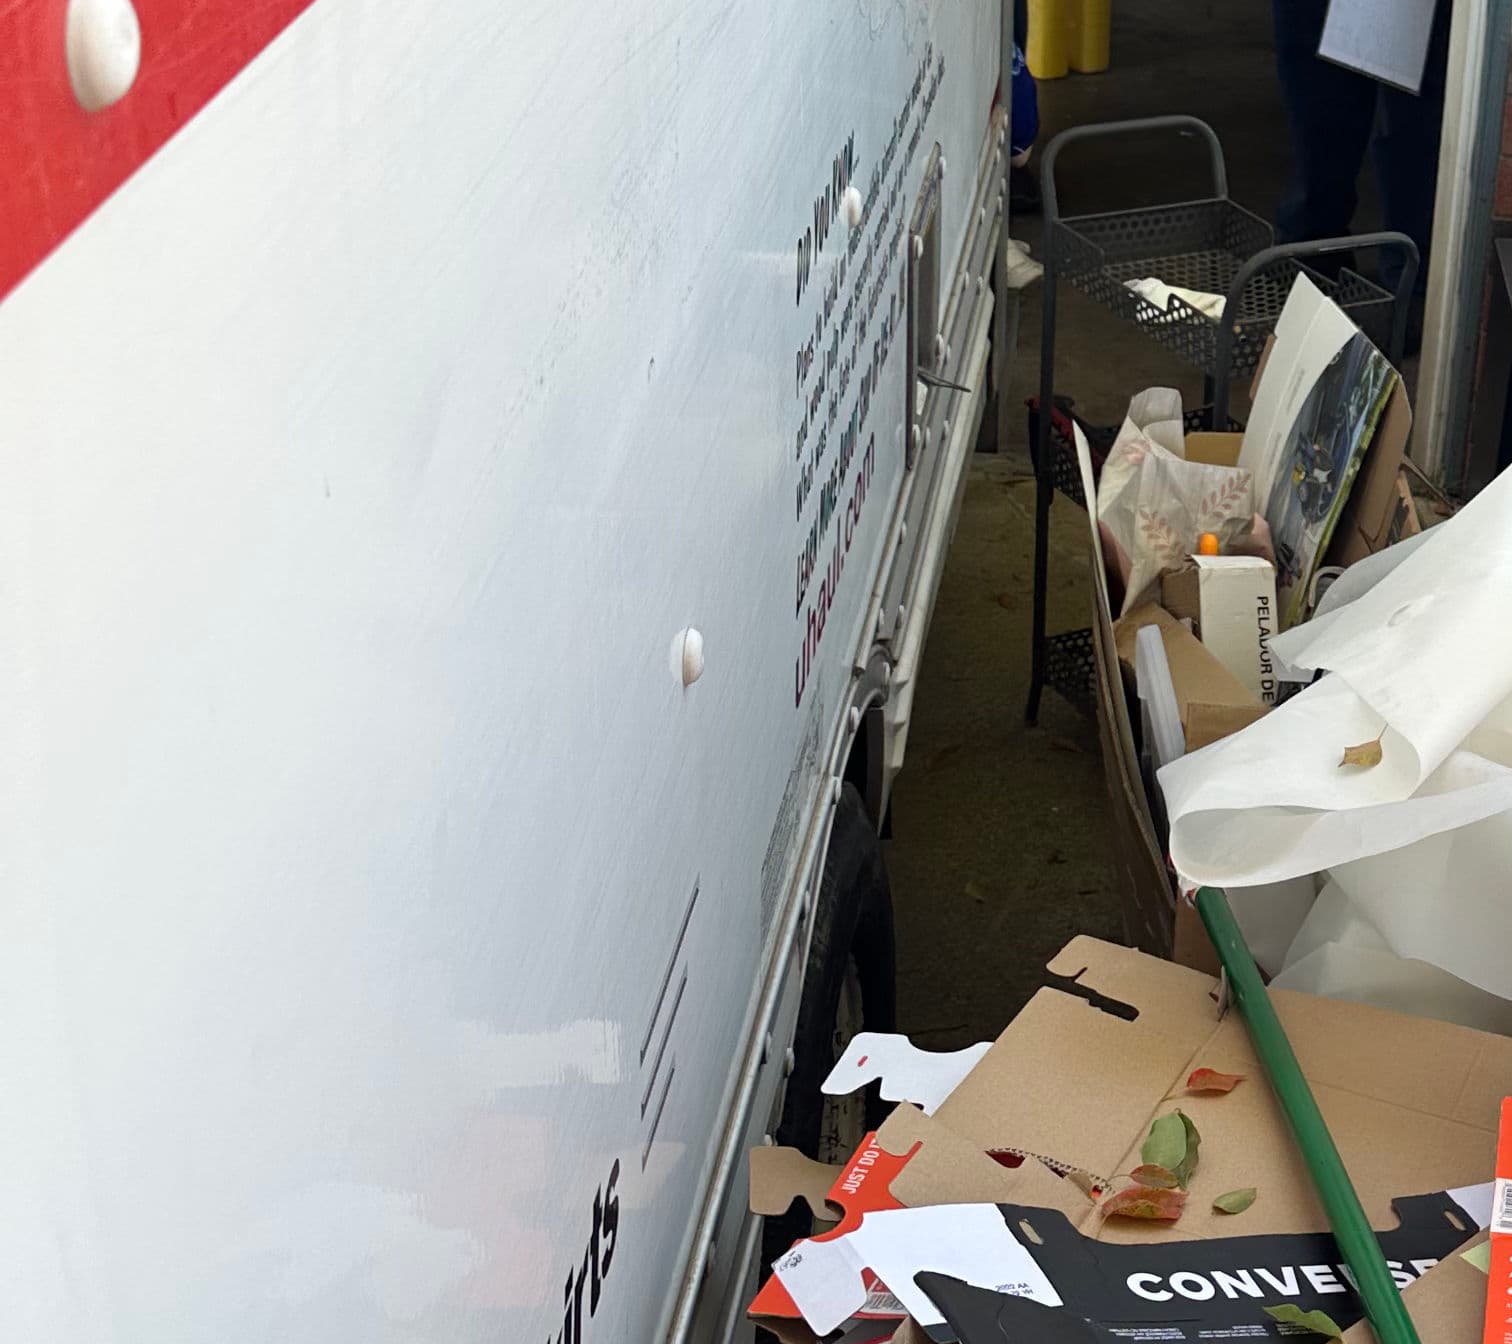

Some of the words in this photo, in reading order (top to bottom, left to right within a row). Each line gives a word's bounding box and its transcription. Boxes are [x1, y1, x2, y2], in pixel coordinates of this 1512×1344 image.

[814, 185, 829, 264] YOU
[796, 432, 874, 707] uhaul.com
[1261, 679, 1275, 702] DE
[841, 1166, 869, 1194] JUST
[858, 1150, 880, 1167] DO
